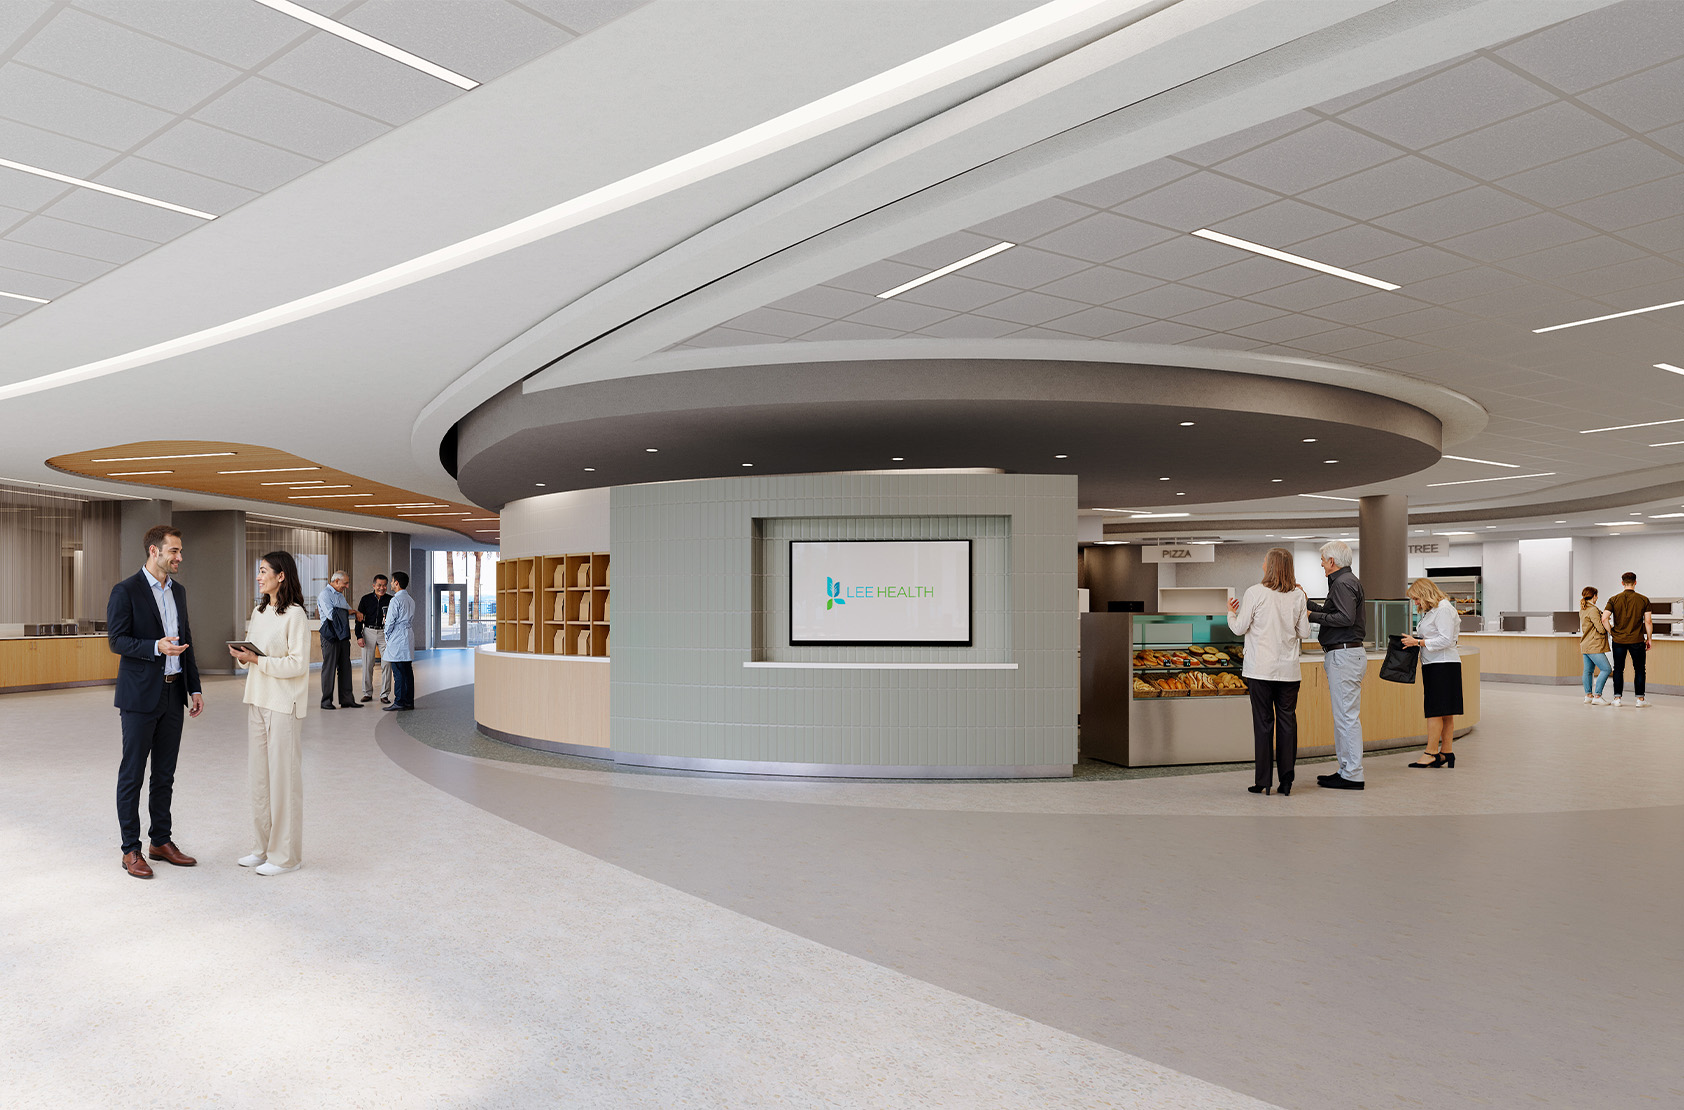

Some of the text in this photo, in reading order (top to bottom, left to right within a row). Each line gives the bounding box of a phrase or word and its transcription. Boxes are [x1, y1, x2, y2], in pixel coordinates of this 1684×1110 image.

[1162, 549, 1192, 558] PIZZA
[846, 586, 934, 598] LEE HEALTH
